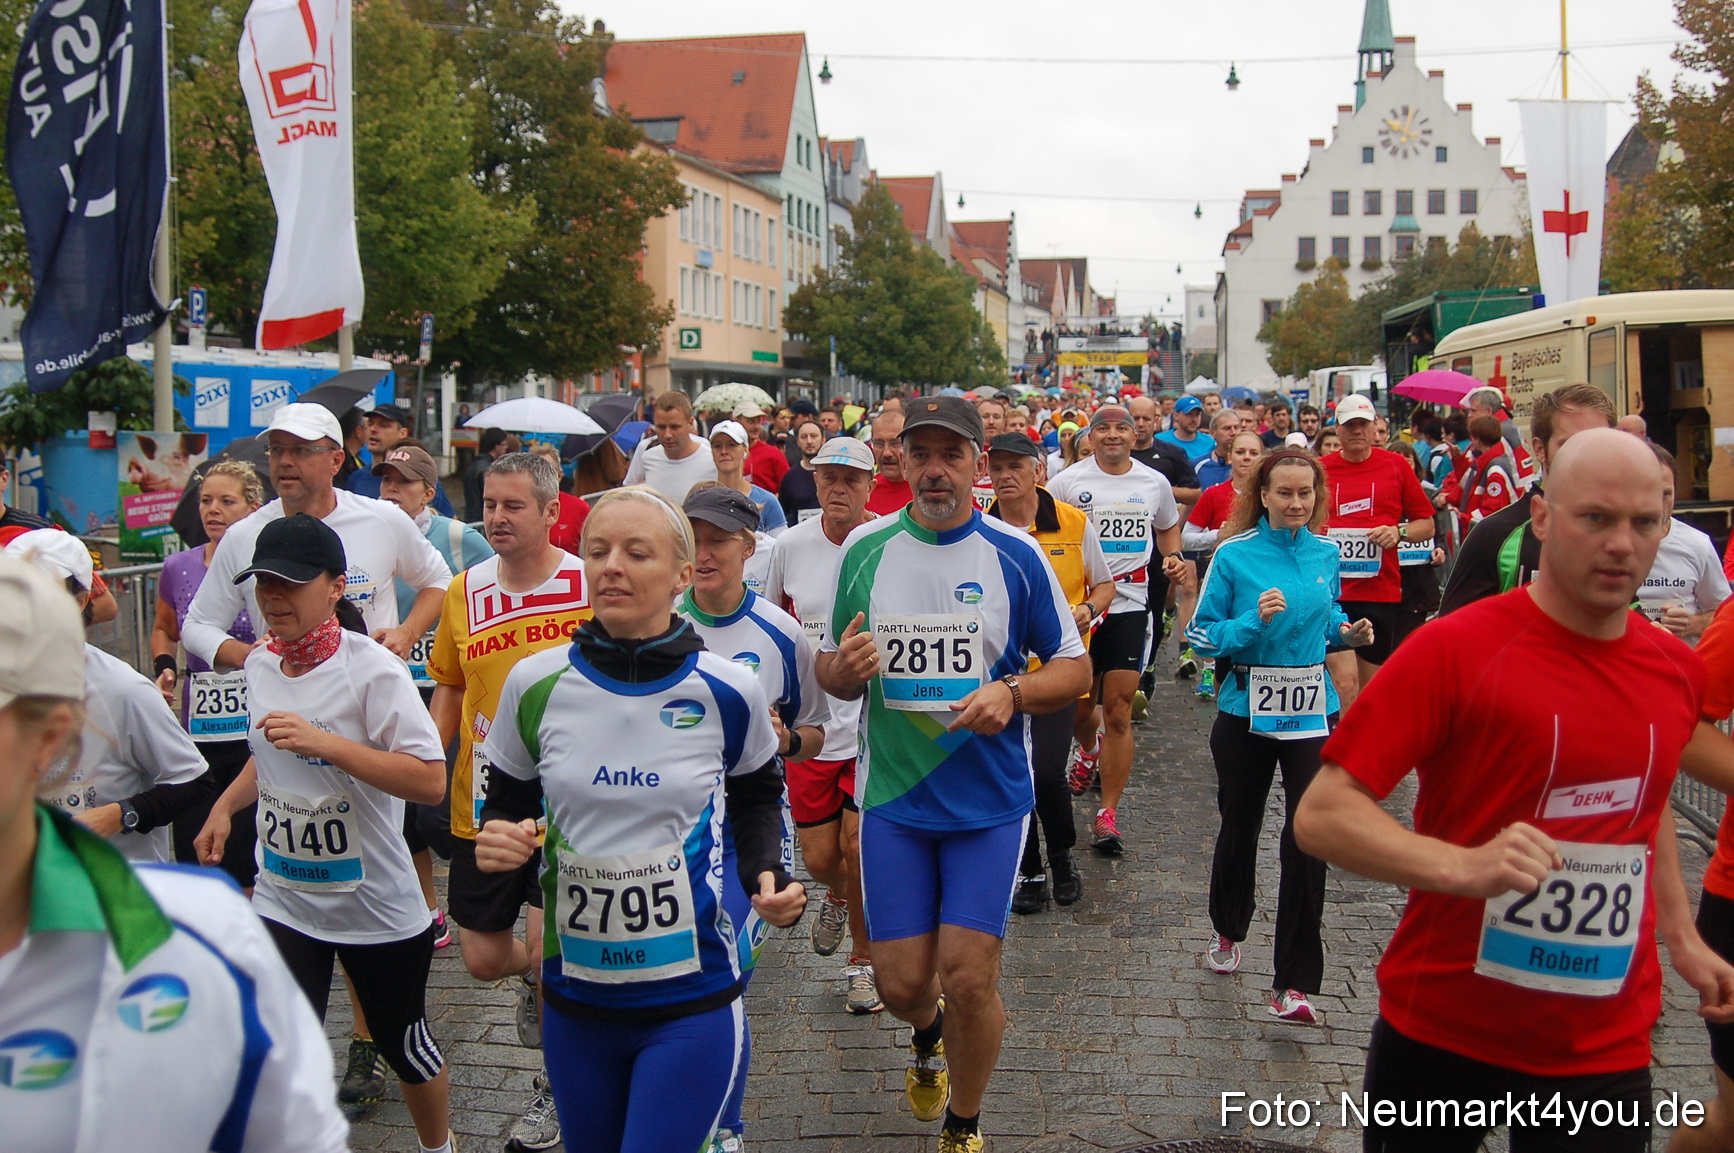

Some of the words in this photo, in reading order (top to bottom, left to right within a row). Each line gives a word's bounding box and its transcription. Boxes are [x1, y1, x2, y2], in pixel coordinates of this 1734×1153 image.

[1087, 354, 1117, 363] START
[1512, 346, 1562, 373] Bayerisches
[1511, 375, 1534, 393] Rotes
[1099, 518, 1146, 538] 2825
[1115, 543, 1130, 552] Can
[877, 624, 910, 633] PARTL
[913, 623, 963, 633] Neumarkt
[466, 629, 519, 660] MAX
[886, 637, 973, 674] 2815
[1252, 674, 1279, 682] PARTL
[1280, 675, 1313, 683] Neumarkt
[912, 683, 944, 697] Jens
[1258, 685, 1319, 712] 2107
[1275, 719, 1300, 730] Petra
[591, 765, 660, 788] Anke
[260, 790, 282, 810] PARTL
[283, 801, 333, 818] Neumarkt
[1571, 790, 1615, 808] DEHN
[264, 810, 349, 856] 2140
[281, 861, 330, 880] Renate
[559, 861, 594, 880] PARTL
[596, 864, 663, 882] Neumarkt
[1560, 857, 1627, 875] Neumarkt
[567, 879, 680, 934] 2795
[1503, 879, 1632, 937] 2328
[601, 948, 646, 966] Anke
[1528, 945, 1599, 974] Robert
